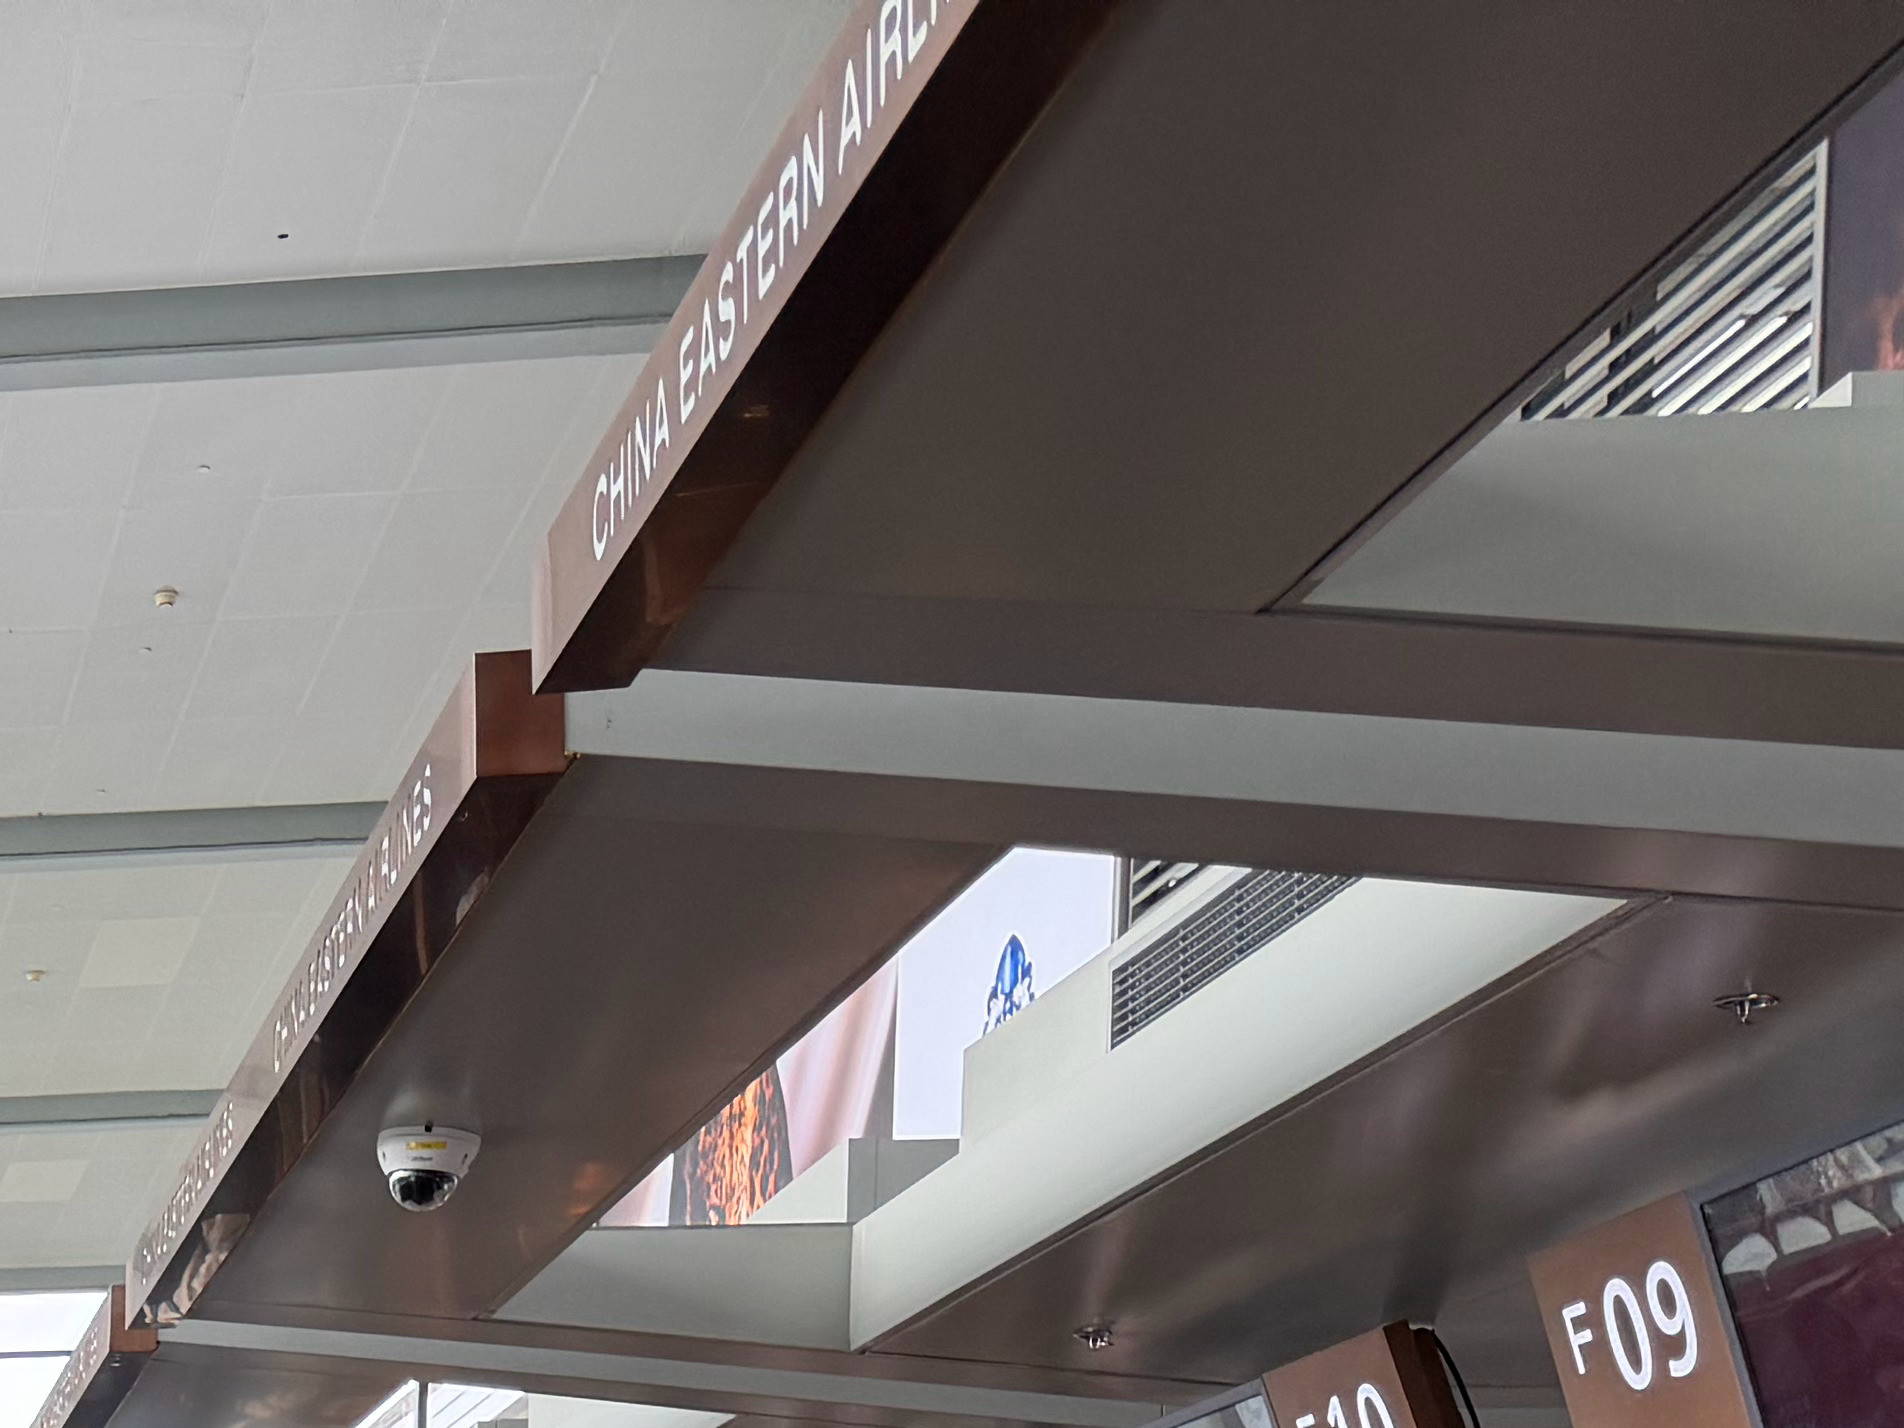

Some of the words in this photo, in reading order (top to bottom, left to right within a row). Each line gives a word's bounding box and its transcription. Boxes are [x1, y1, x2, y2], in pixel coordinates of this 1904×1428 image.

[592, 377, 670, 561] CHINA
[679, 108, 824, 424] EASTERN
[837, 0, 949, 176] AIRL
[1561, 1260, 1699, 1392] F09
